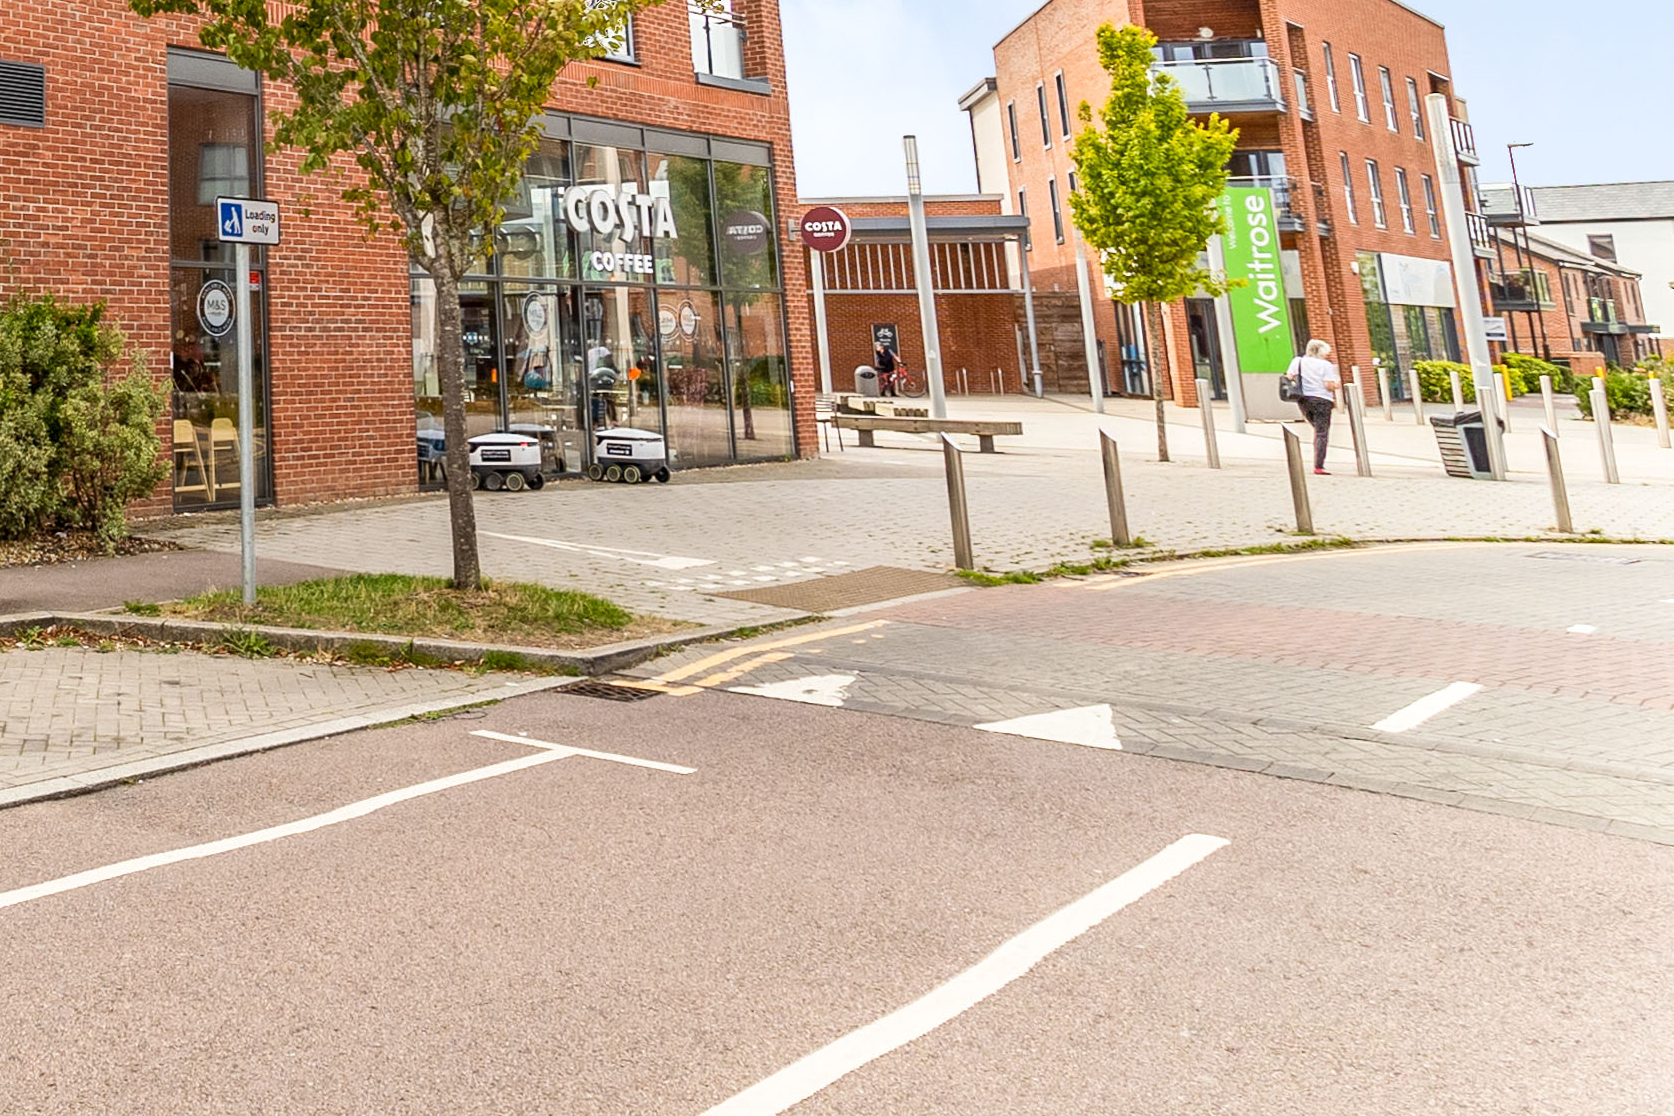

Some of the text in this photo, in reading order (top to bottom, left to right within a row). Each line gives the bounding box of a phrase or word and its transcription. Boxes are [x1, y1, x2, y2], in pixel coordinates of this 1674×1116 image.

[244, 209, 275, 223] Loading
[564, 186, 677, 242] COSTA
[252, 224, 269, 236] only
[804, 221, 842, 232] COSTA
[593, 251, 653, 274] COFFEE
[1245, 195, 1282, 333] Waitrose
[207, 299, 226, 311] M&S
